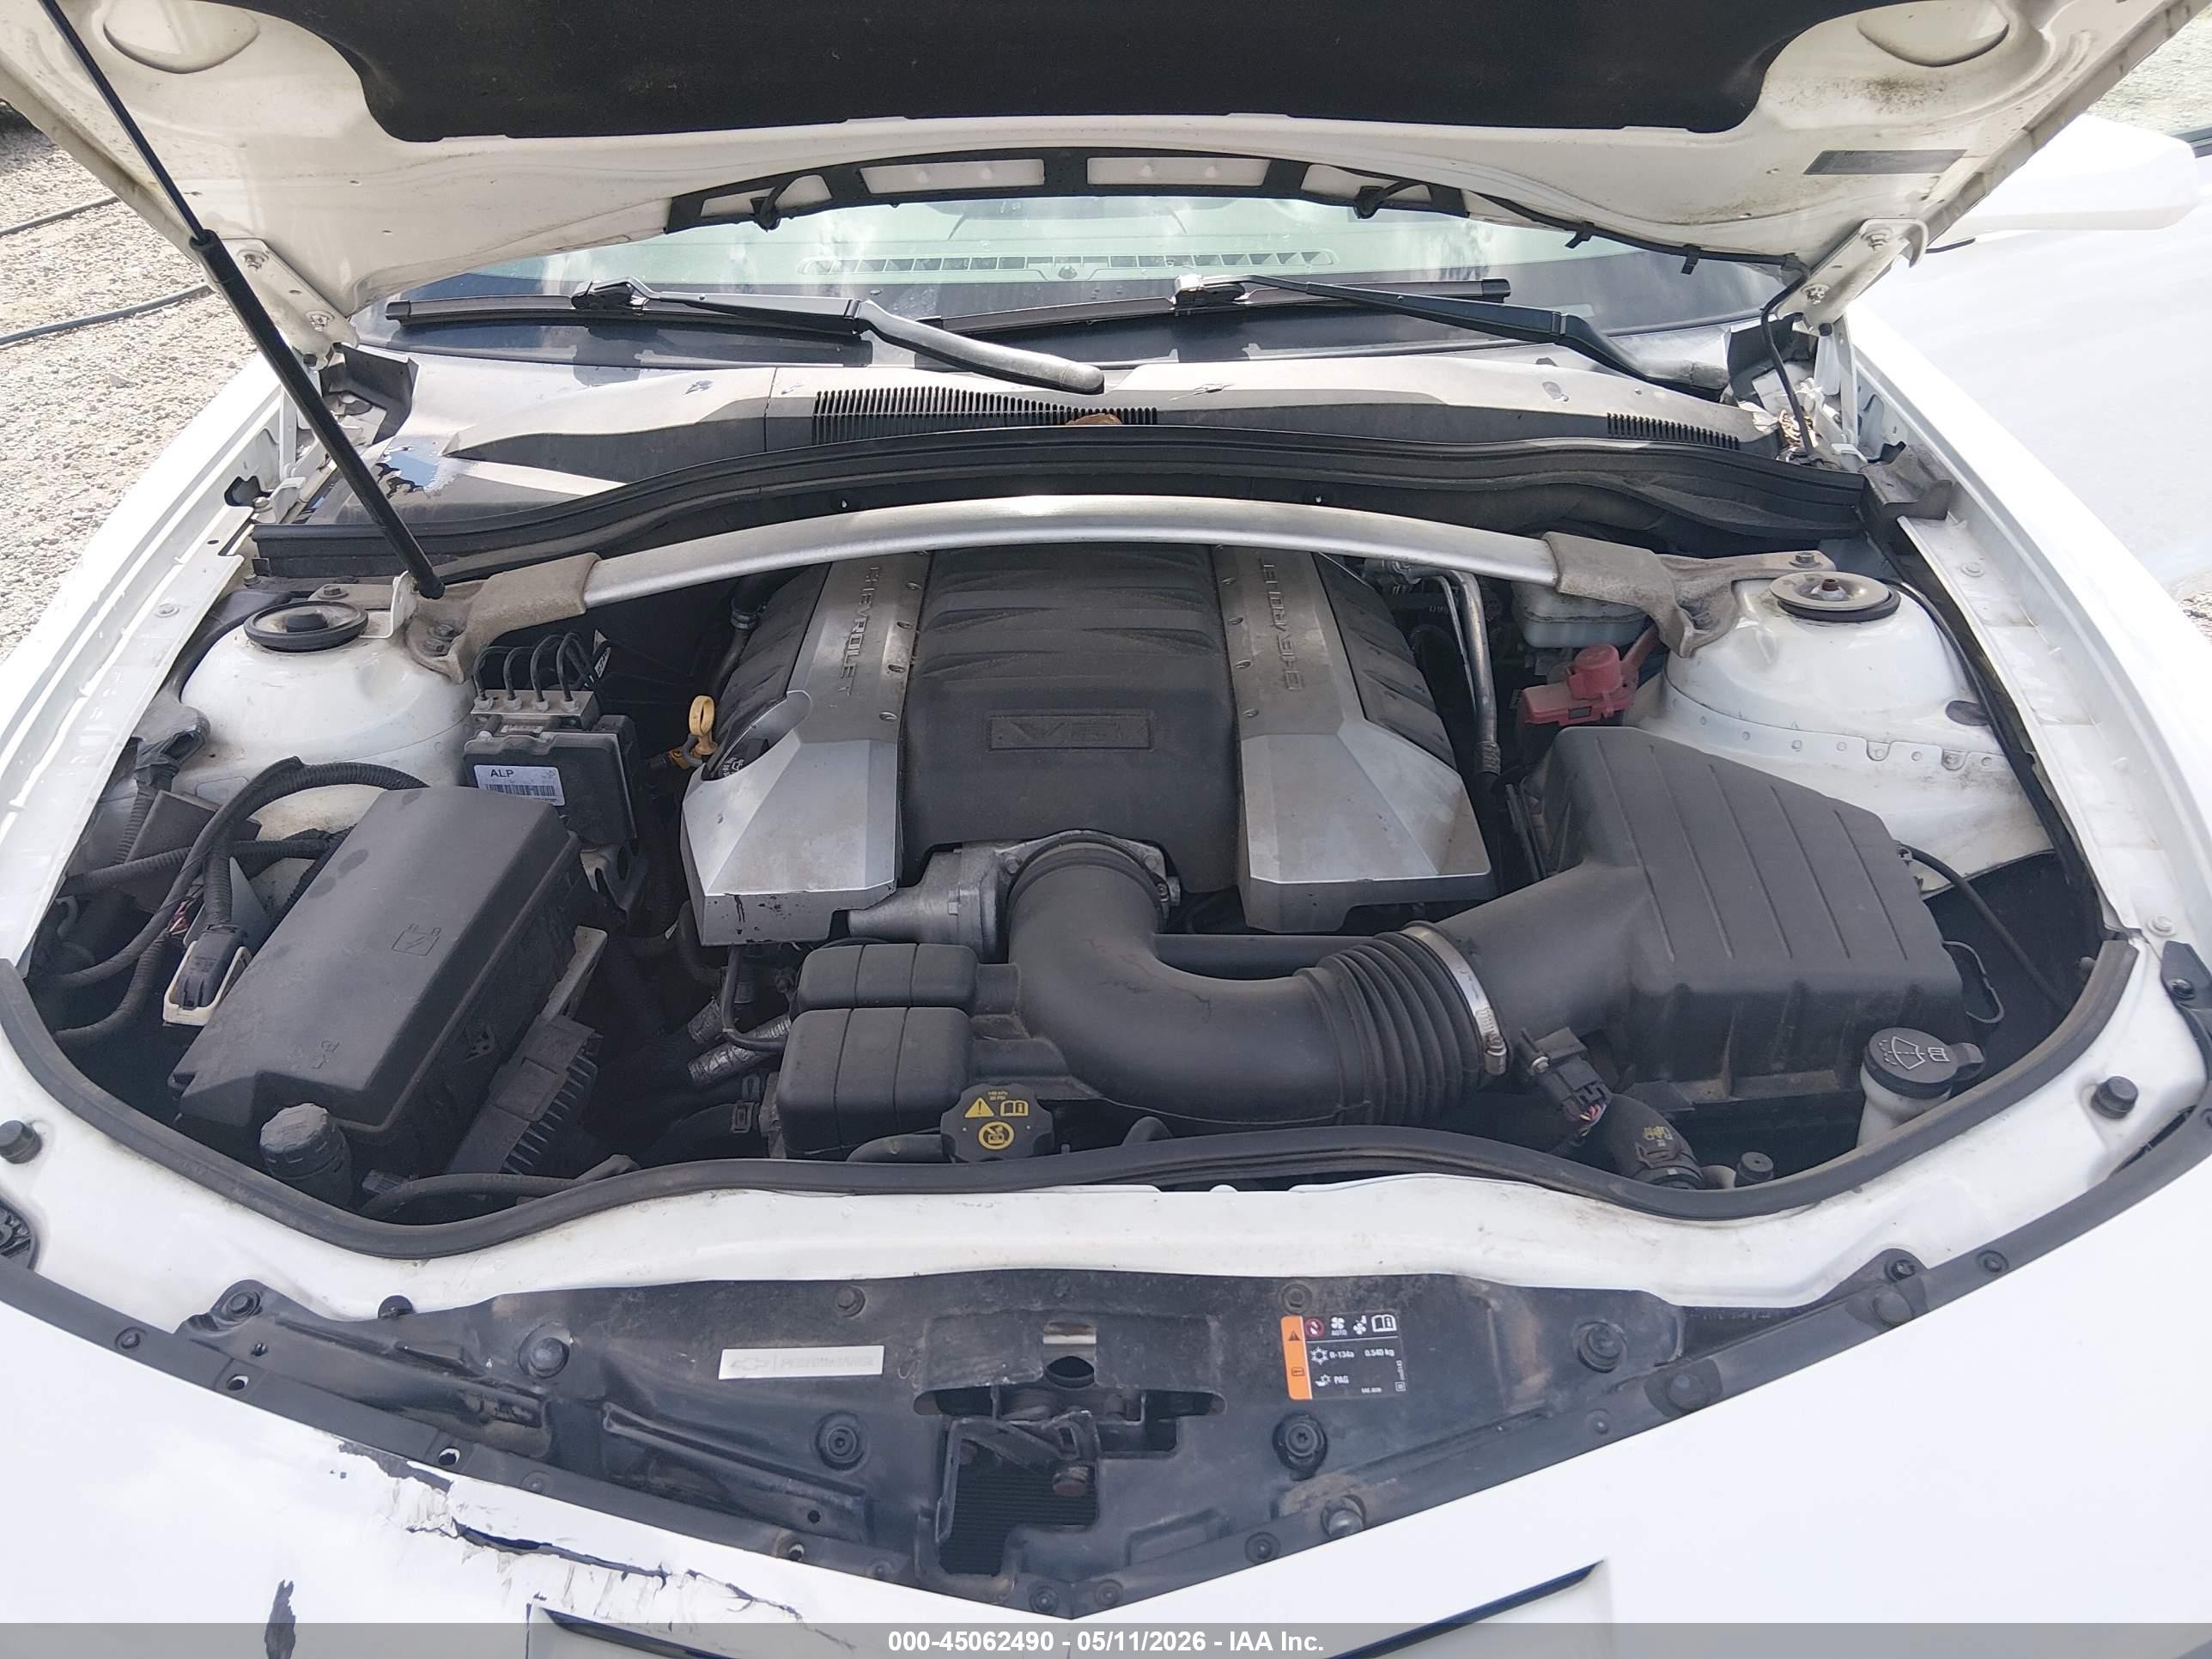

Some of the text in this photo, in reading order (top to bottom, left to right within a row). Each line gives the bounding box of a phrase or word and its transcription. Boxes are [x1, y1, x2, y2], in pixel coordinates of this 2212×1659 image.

[1257, 558, 1304, 692] CHEVROLET
[837, 566, 880, 697] CHEVROLET
[490, 769, 514, 778] ALP
[1329, 1350, 1355, 1358] R-134a
[1334, 1375, 1350, 1384] PAG
